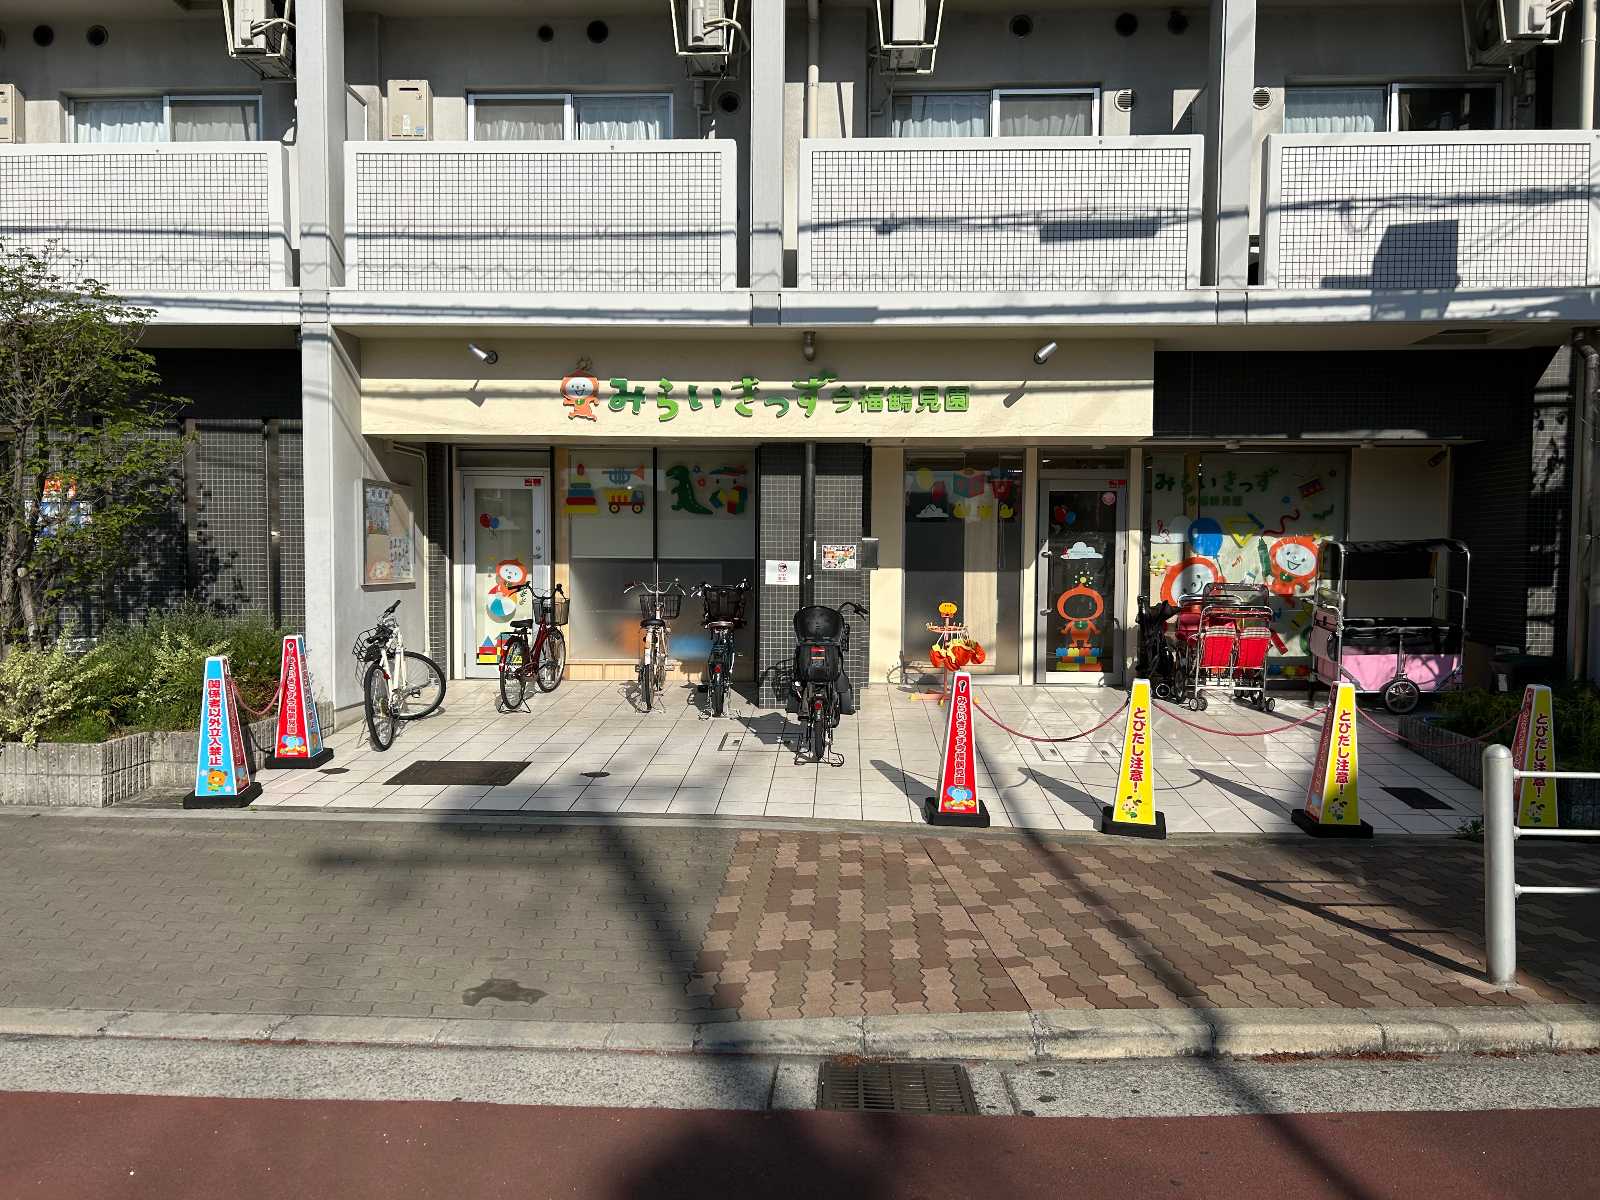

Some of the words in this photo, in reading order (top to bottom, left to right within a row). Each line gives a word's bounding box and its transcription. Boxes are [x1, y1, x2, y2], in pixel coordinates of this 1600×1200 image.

[208, 680, 222, 766] 関係者以外立入禁止
